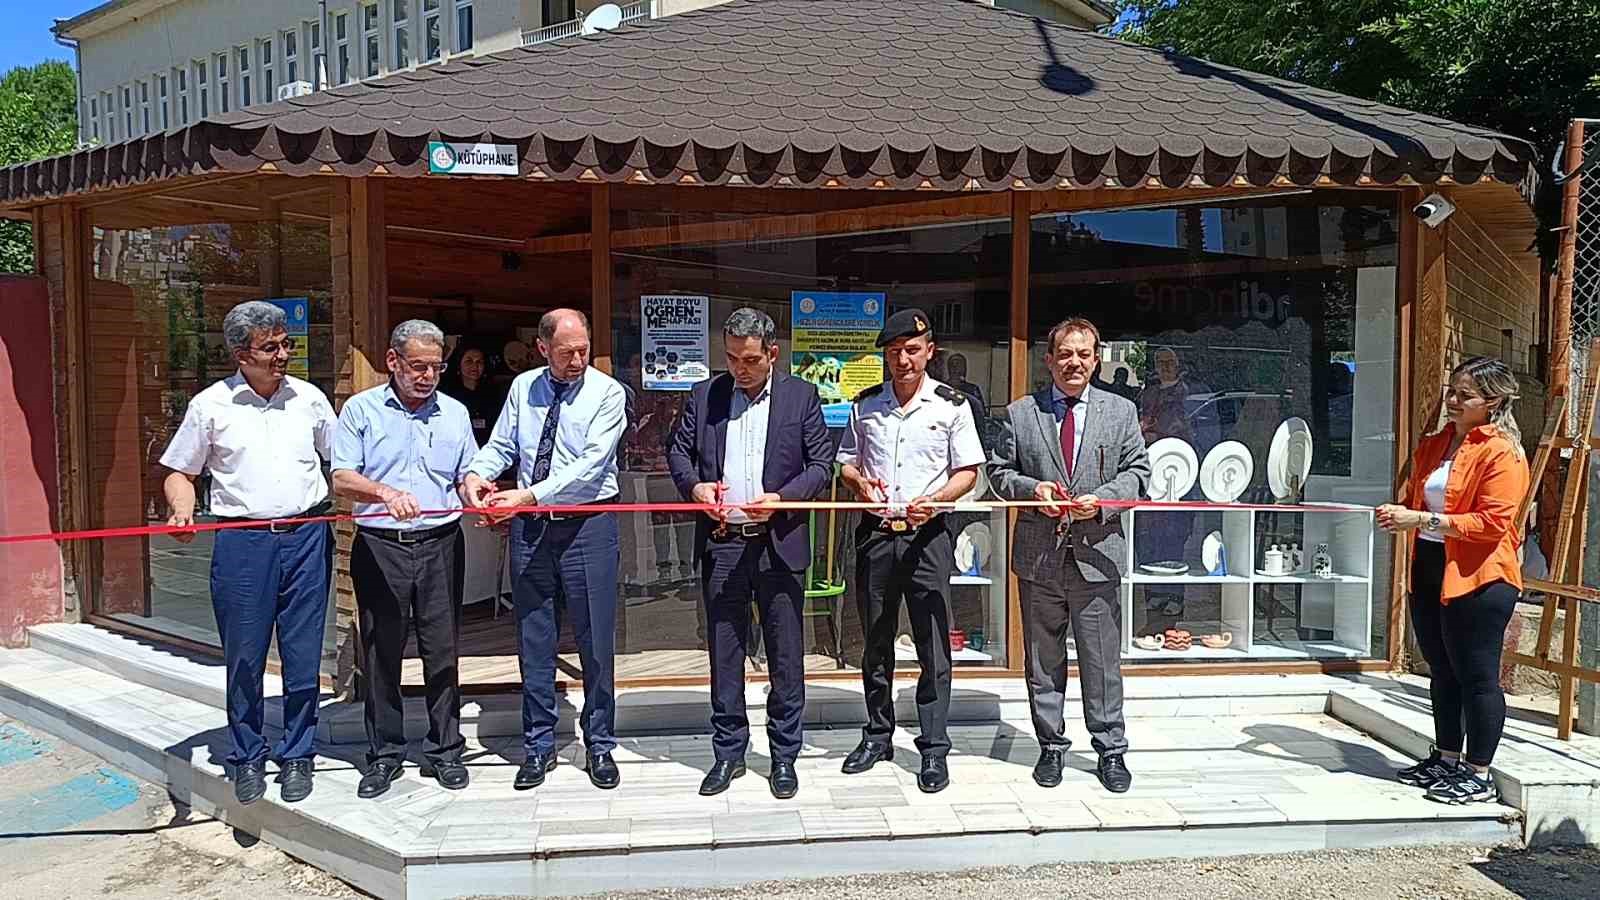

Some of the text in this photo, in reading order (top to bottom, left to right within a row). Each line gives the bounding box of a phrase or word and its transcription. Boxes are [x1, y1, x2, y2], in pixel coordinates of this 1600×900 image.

[457, 149, 516, 166] KÜTÜPHANE
[646, 298, 701, 306] HAYAT BOYU
[647, 317, 702, 329] ME HAFTASI
[1458, 779, 1482, 794] N
